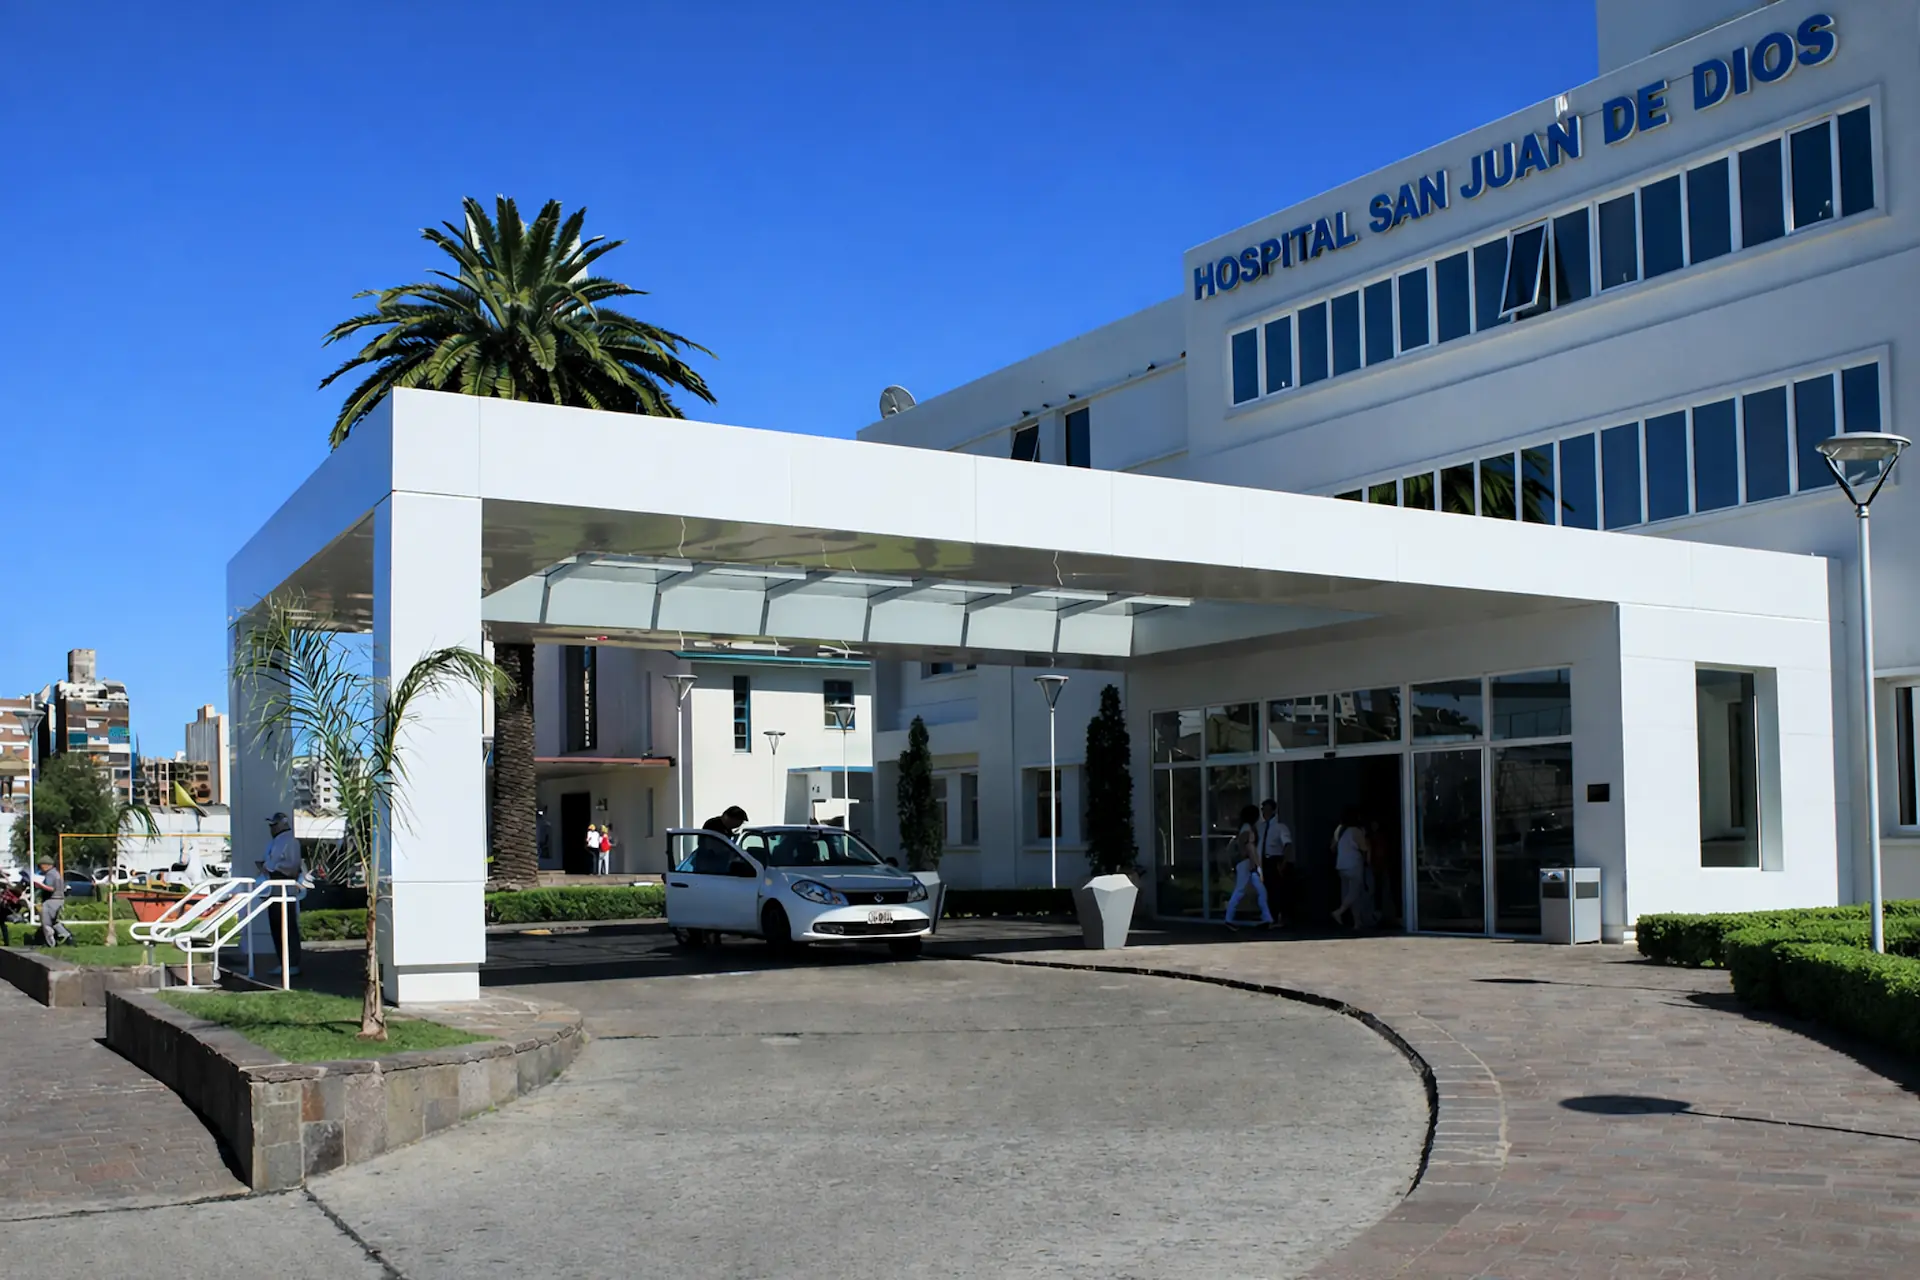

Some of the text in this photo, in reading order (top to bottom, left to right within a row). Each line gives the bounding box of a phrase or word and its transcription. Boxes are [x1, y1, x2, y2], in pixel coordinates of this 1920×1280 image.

[1194, 14, 1837, 300] HOSPITAL SAN JUAN DE DIOS
